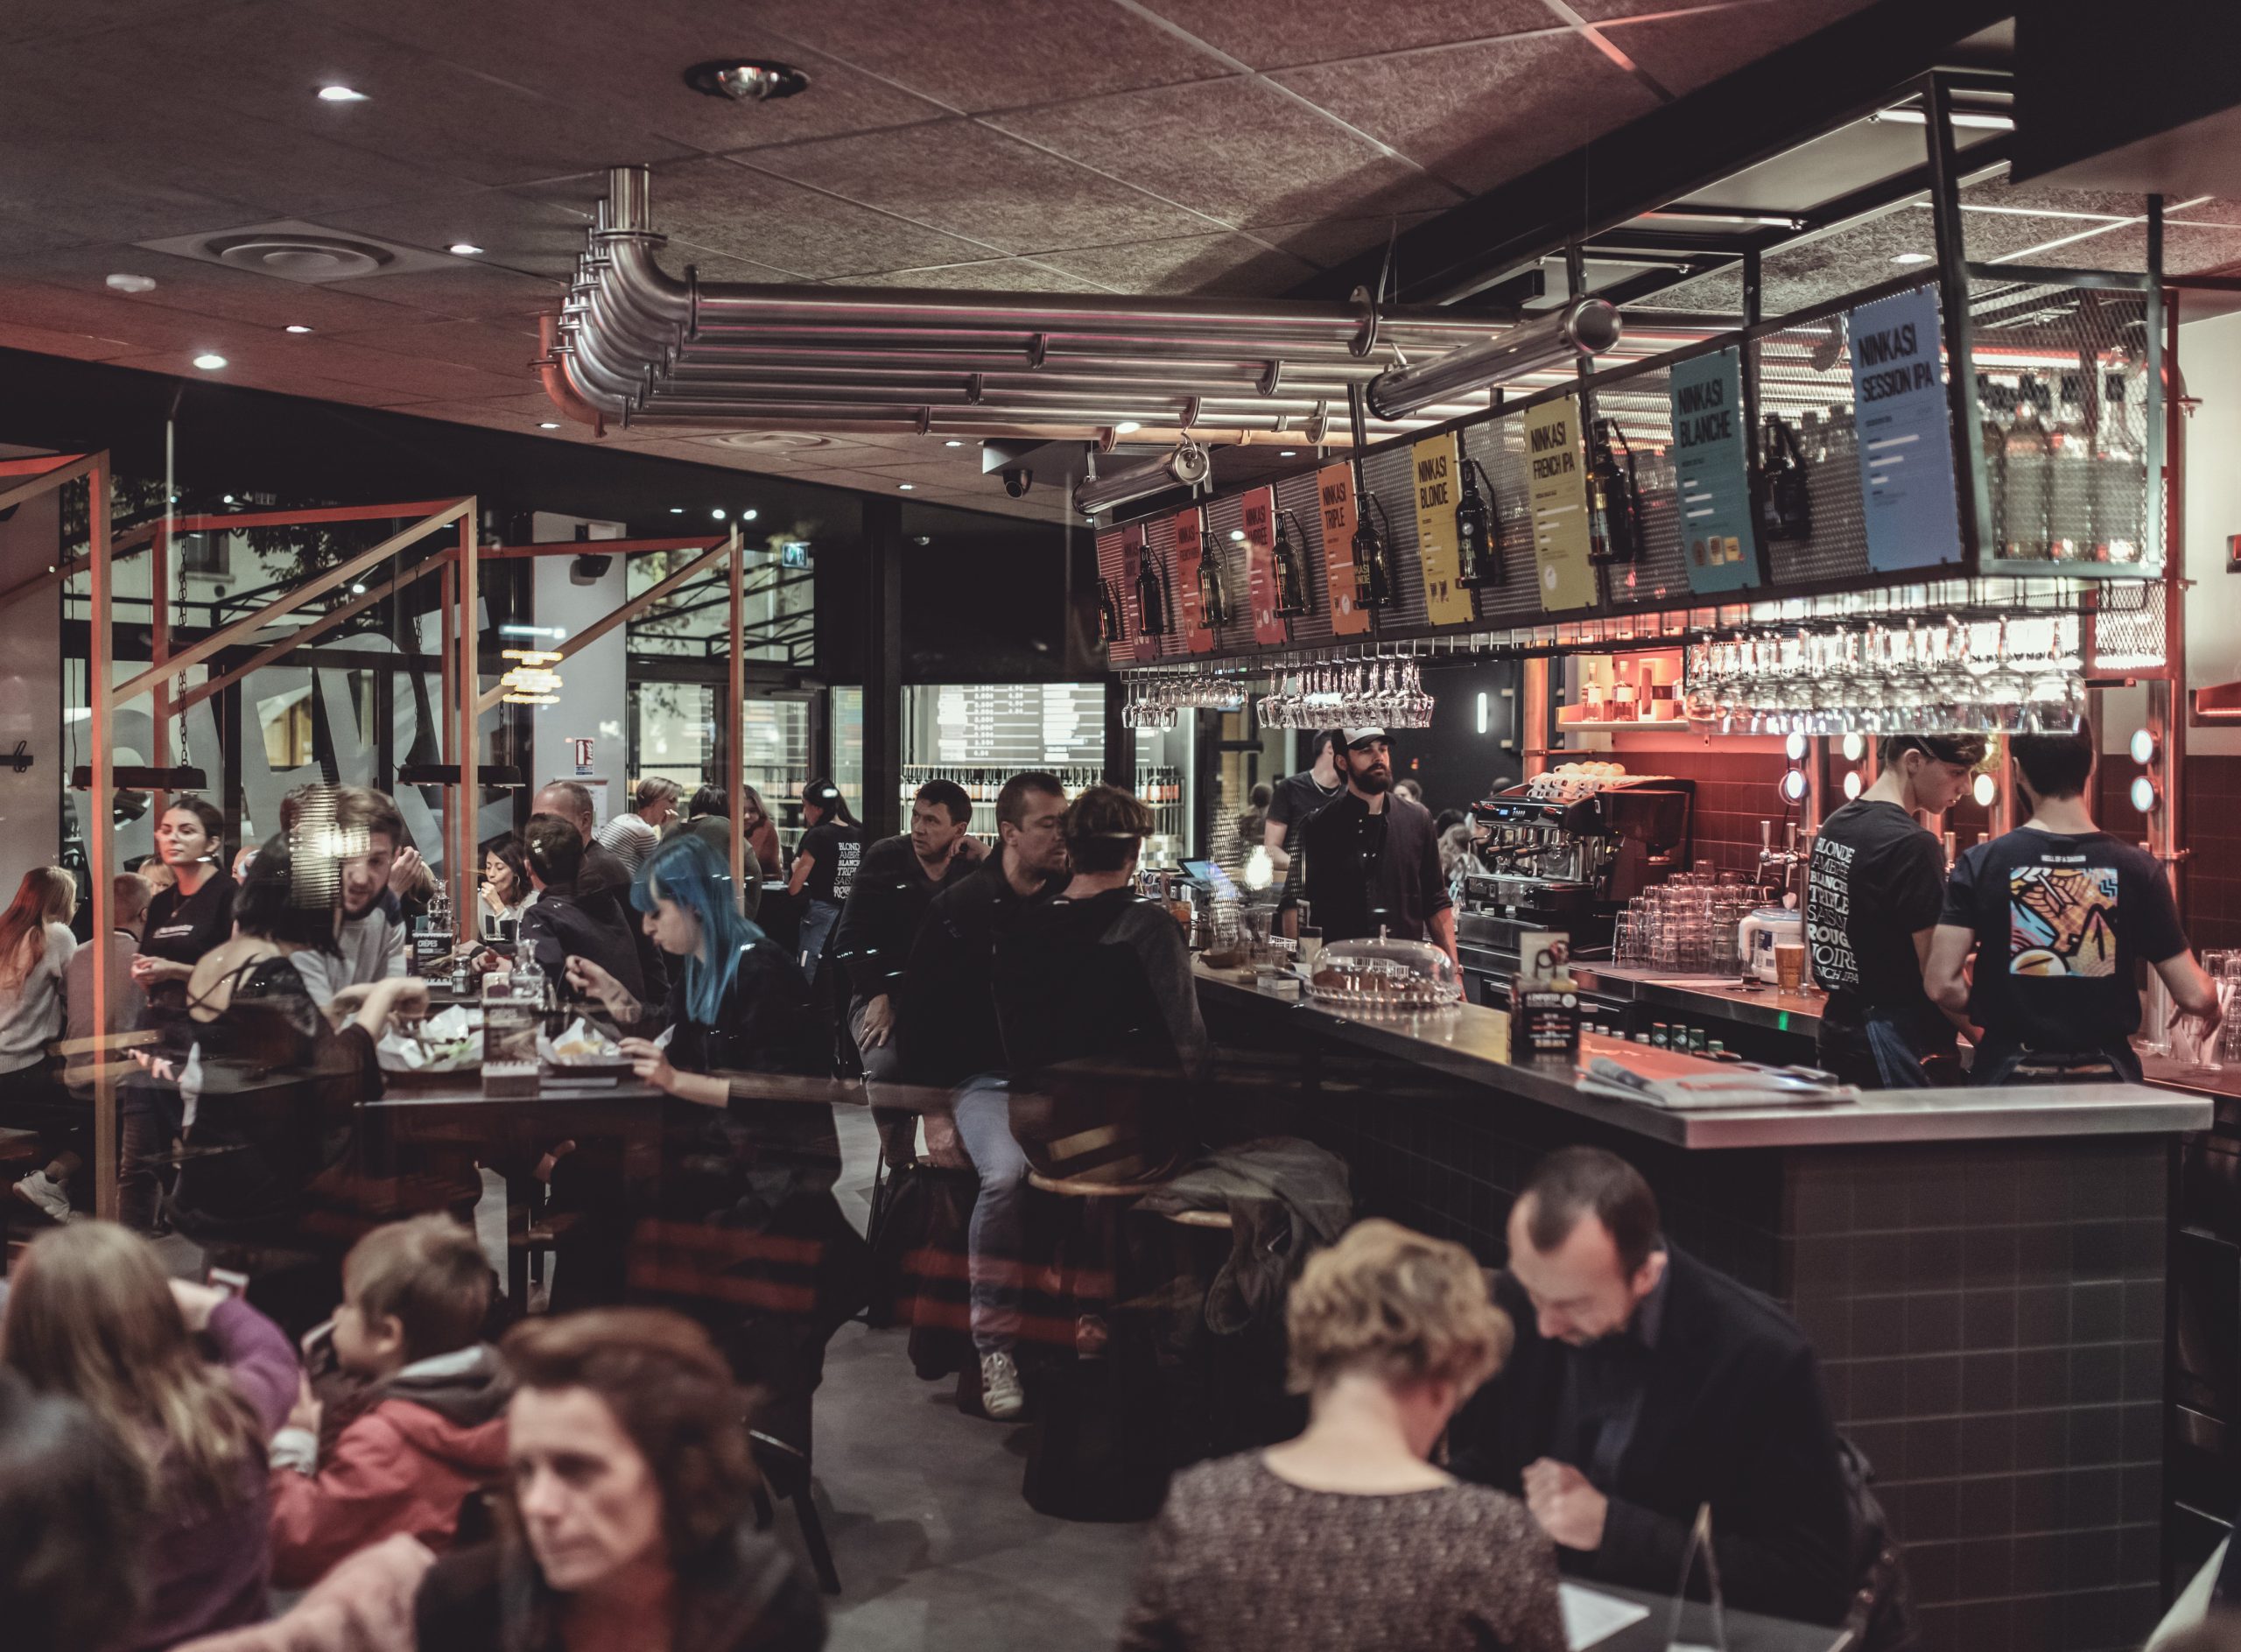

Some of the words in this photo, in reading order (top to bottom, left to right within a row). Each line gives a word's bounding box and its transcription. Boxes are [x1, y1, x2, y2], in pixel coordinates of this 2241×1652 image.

[1858, 322, 1918, 369] NINKASI
[1861, 366, 1912, 403] SESSION
[1913, 361, 1935, 390] IPA
[1676, 378, 1724, 416] NINKASI
[1530, 420, 1567, 453] NINKASI
[1679, 410, 1732, 448] BLANCHE
[1418, 455, 1447, 484] NINKASI
[1533, 454, 1562, 481] FRENCH
[1563, 451, 1576, 475] IPA
[1323, 482, 1347, 507] NINKASI
[1420, 482, 1449, 510] BLONDE
[1246, 504, 1266, 527] NINKASI
[1324, 507, 1345, 530] TRIPLE
[838, 842, 861, 851] BLOND
[1815, 837, 1855, 863] BLONDE
[837, 867, 857, 876] TRIP
[1809, 884, 1850, 915] TRIPLE
[1807, 923, 1851, 949] ROUG
[1842, 970, 1859, 984] IPA
